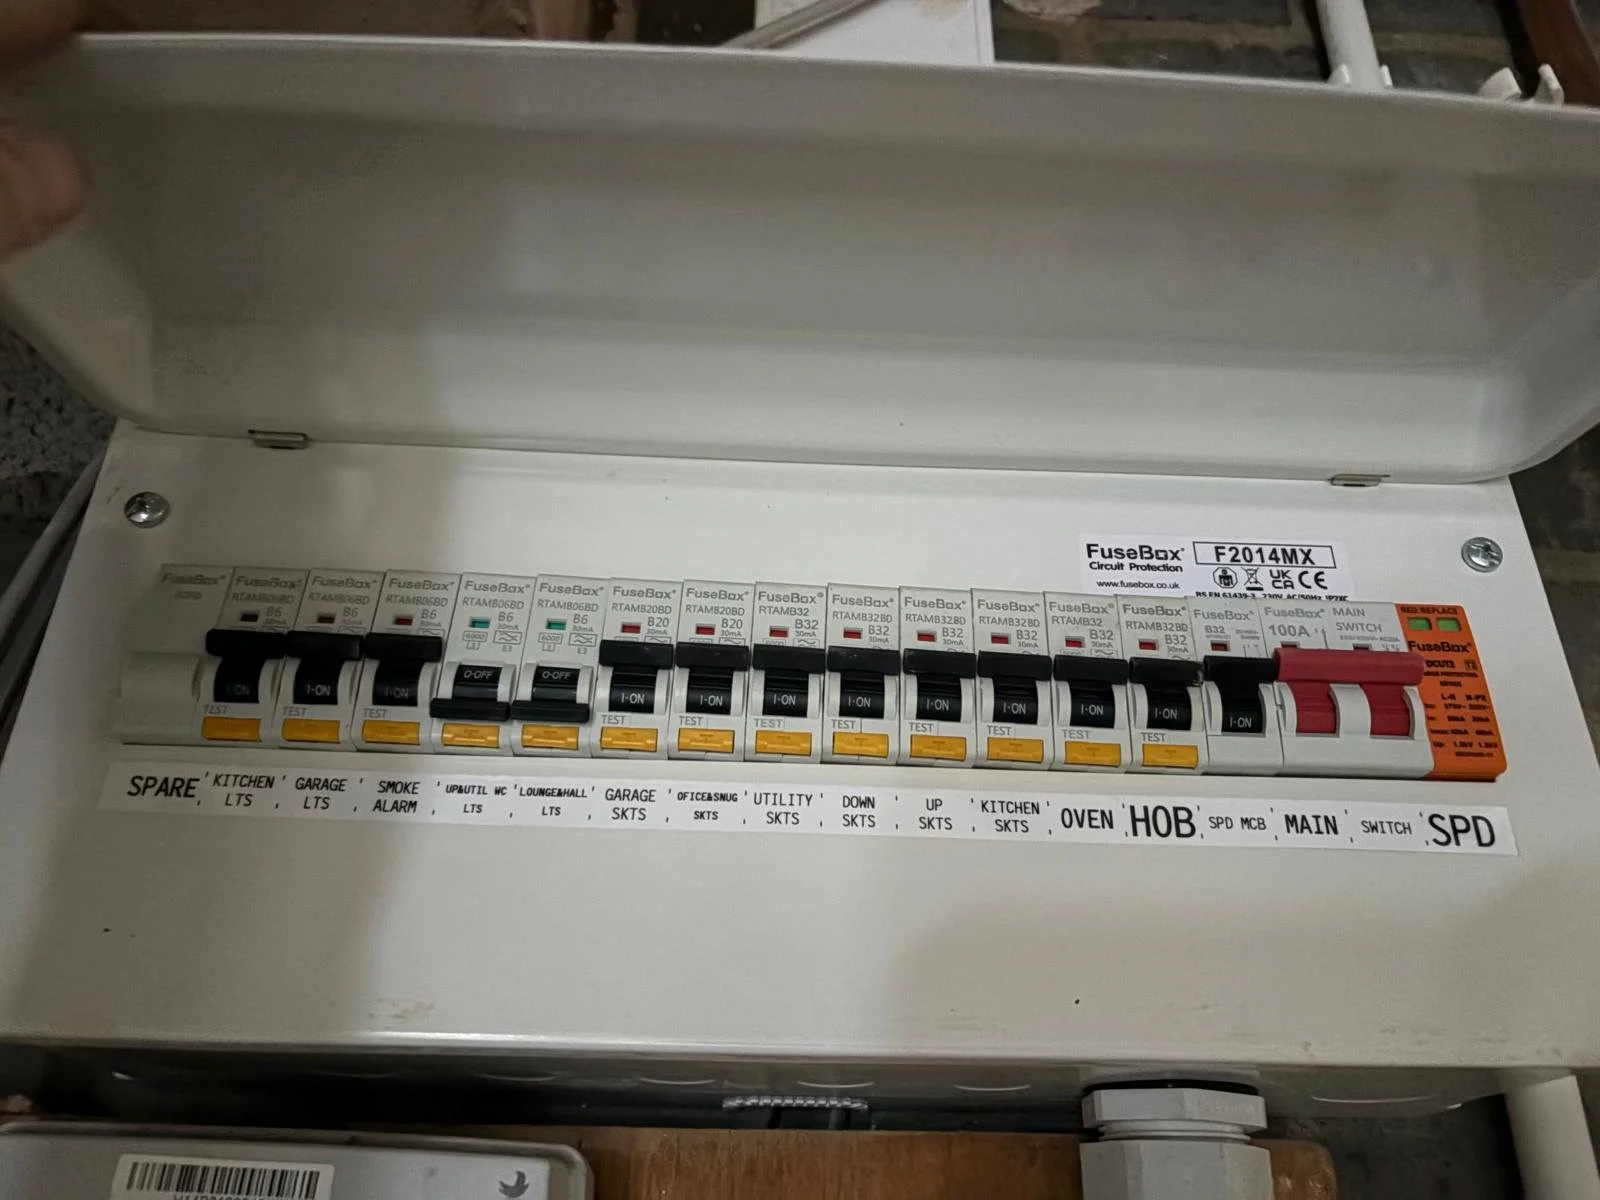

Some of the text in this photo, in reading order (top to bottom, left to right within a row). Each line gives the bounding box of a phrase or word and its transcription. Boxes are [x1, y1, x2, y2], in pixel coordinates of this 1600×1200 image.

[1086, 543, 1182, 562] FuseBox
[1214, 545, 1315, 566] F2014MX
[1089, 561, 1183, 573] Circuit Protection
[388, 577, 449, 591] FuseBox
[464, 580, 525, 594] FuseBox
[540, 582, 600, 597] FuseBox
[1096, 580, 1181, 591] www.fusebox.co.uk
[613, 585, 671, 600] FuseBox
[686, 587, 744, 602] FuseBox
[758, 590, 817, 605] FuseBox
[832, 594, 889, 608] FuseBox
[904, 596, 962, 611] FuseBox
[977, 598, 1036, 613] FuseBox
[421, 609, 437, 619] B6
[685, 604, 745, 616] RTAMB20BD
[758, 605, 810, 616] RTAMB32
[1048, 601, 1109, 615] FuseBox
[1122, 603, 1182, 617] FuseBox
[1193, 608, 1251, 621] FuseBox
[1264, 606, 1322, 619] FuseBox
[1333, 607, 1366, 617] MAIN
[498, 612, 514, 622] B6
[573, 614, 588, 624] B6
[647, 617, 669, 628] B20
[721, 618, 743, 629] B20
[905, 613, 966, 626] RTAMB32BD
[978, 615, 1040, 628] RTAMB32BD
[1051, 615, 1103, 627] RTAMB32
[795, 619, 819, 630] B32
[868, 624, 890, 636] B32
[1205, 625, 1225, 634] B32
[1268, 624, 1310, 637] 100A
[1335, 622, 1383, 633] SWITCH
[720, 629, 742, 638] 30mA
[795, 630, 817, 638] 30mA
[942, 627, 964, 639] B32
[1016, 629, 1038, 641] B32
[1089, 629, 1114, 641] B32
[1164, 634, 1188, 645] B32
[1408, 640, 1470, 653] FuseBox
[282, 706, 307, 716] TEST
[363, 708, 388, 718] TEST
[601, 714, 626, 725] TEST
[678, 715, 704, 726] TEST
[754, 718, 783, 729] TEST
[831, 719, 856, 730] TEST
[909, 722, 934, 733] TEST
[987, 725, 1012, 736] TEST
[1062, 729, 1091, 740] TEST
[1141, 732, 1166, 742] TEST
[127, 775, 200, 798] SPARE
[212, 774, 275, 789] KITCHEN
[295, 777, 348, 792] GARAGE
[377, 780, 420, 795] SMOKE
[446, 784, 508, 795] UP&UTIL WC
[519, 786, 587, 798] LOUNGE&HALL
[605, 788, 656, 802] GARAGE
[224, 793, 253, 807] LTS
[303, 796, 330, 810] LTS
[677, 791, 738, 802] OFICE&SNUG
[754, 792, 813, 806] UTILITY
[842, 795, 875, 809] DOWN
[373, 799, 418, 813] ALARM
[463, 804, 483, 813] LTS
[541, 806, 561, 816] LTS
[926, 798, 943, 811] UP
[981, 800, 1040, 815] KITCHEN
[612, 807, 646, 821] SKTS
[694, 810, 718, 820] SKTS
[766, 811, 800, 825] SKTS
[1060, 807, 1114, 830] OVEN
[842, 814, 876, 828] SKTS
[919, 816, 953, 830] SKTS
[994, 819, 1029, 833] SKTS
[1130, 804, 1196, 838] HOB
[1208, 816, 1267, 830] SPD MCB
[1284, 813, 1339, 835] MAIN
[1361, 820, 1412, 835] SWITCH
[1428, 813, 1496, 848] SPD
